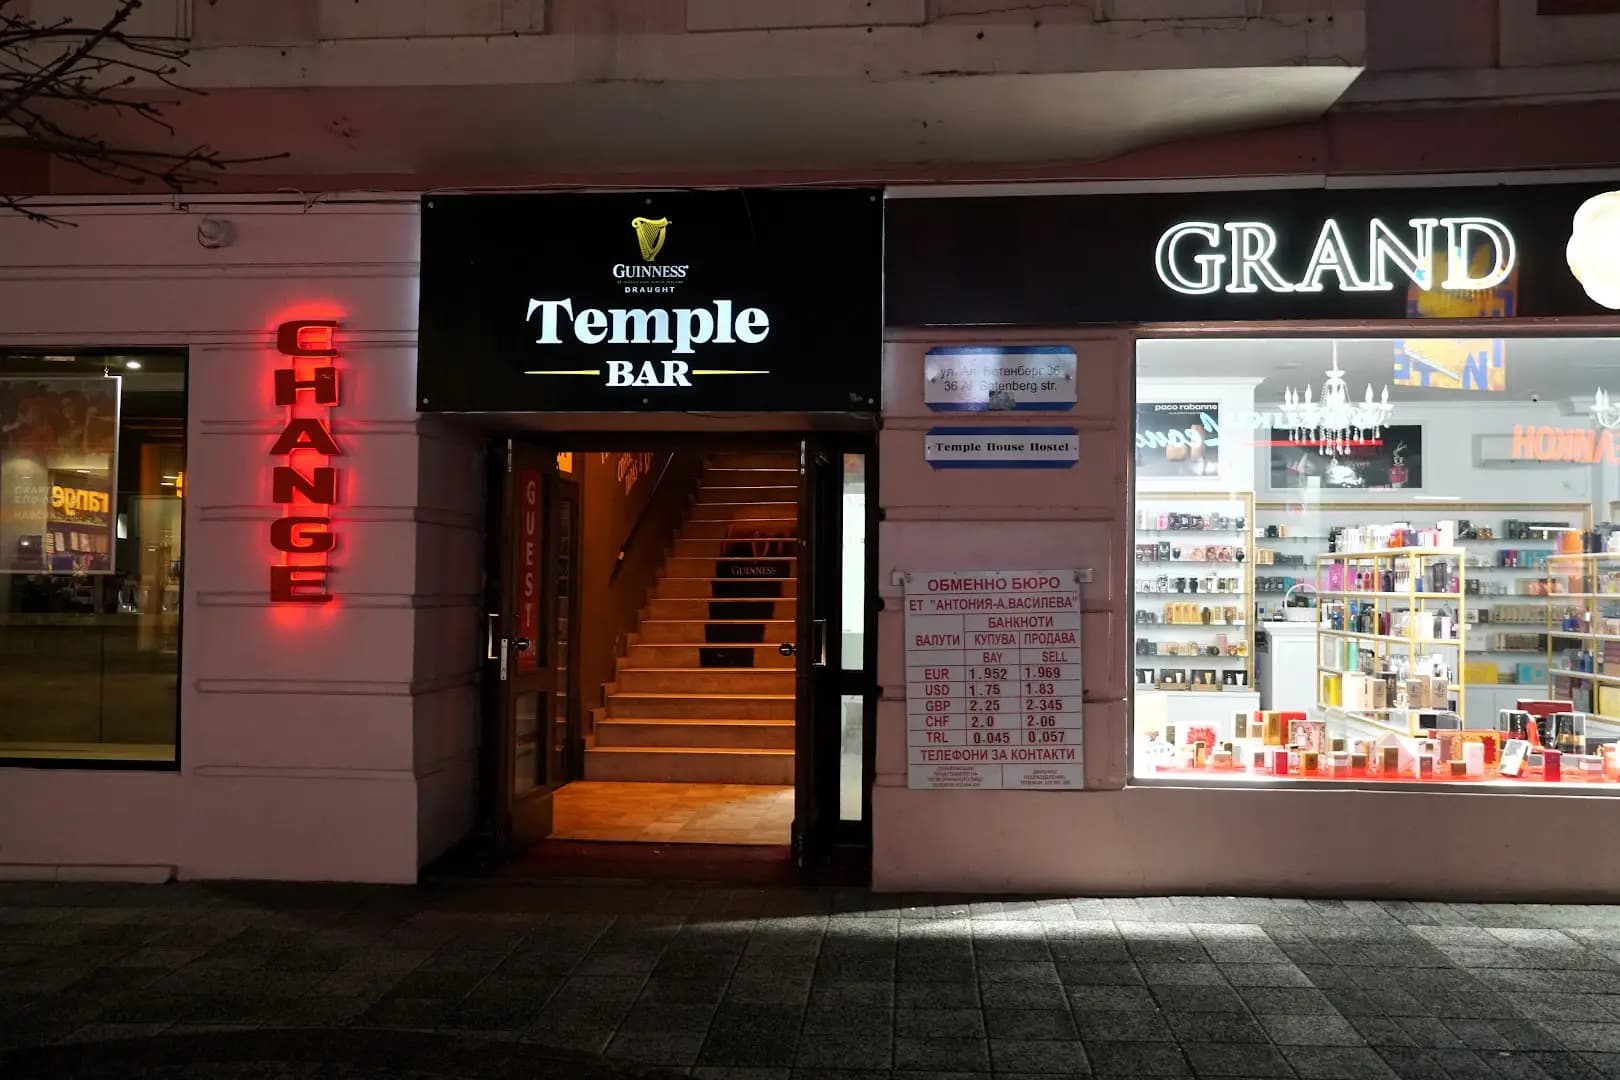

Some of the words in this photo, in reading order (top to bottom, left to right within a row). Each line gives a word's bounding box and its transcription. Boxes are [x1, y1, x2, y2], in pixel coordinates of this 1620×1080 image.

[1154, 216, 1517, 294] GRAND
[612, 263, 689, 279] GUINNESS
[624, 286, 676, 294] DRAUGHT
[525, 297, 770, 354] Temple
[605, 360, 692, 387] BAR
[944, 381, 958, 392] 36
[1041, 381, 1057, 391] str.
[935, 442, 981, 453] Temple
[987, 442, 1025, 452] House
[1030, 442, 1069, 452] Hostel
[270, 320, 342, 603] CHANGE
[523, 479, 537, 628] GUEST
[731, 566, 777, 576] GUINNESS
[928, 578, 1007, 592] ОБМЕННО
[1012, 576, 1061, 590] БЮРО
[909, 599, 924, 611] ЕТ
[988, 615, 1053, 629] БАНКНОТИ
[915, 634, 960, 647] ВАЛУТИ
[974, 633, 1016, 646] КУПУВА
[1024, 632, 1076, 646] ПРОДАВА
[1041, 650, 1068, 663] SELL
[925, 668, 949, 680] EUR
[968, 668, 1007, 680] 1.952
[1025, 666, 1061, 679] 1.969
[925, 684, 950, 696] USD
[968, 683, 1000, 697] 1.75
[1026, 683, 1054, 695] 1.83
[925, 700, 951, 712] GBP
[969, 699, 1000, 712] 2.25
[1026, 699, 1063, 711] 2.345
[925, 715, 949, 727] CHF
[971, 715, 994, 728] 2.0
[1027, 714, 1056, 727] 2.06
[927, 731, 949, 743] TRL
[973, 731, 1010, 744] 0.045
[1028, 730, 1065, 743] 0.057
[921, 749, 988, 761] ТЕЛЕФОНИ
[991, 749, 1008, 761] ЗА
[1011, 748, 1075, 761] КОНТАКТИ
